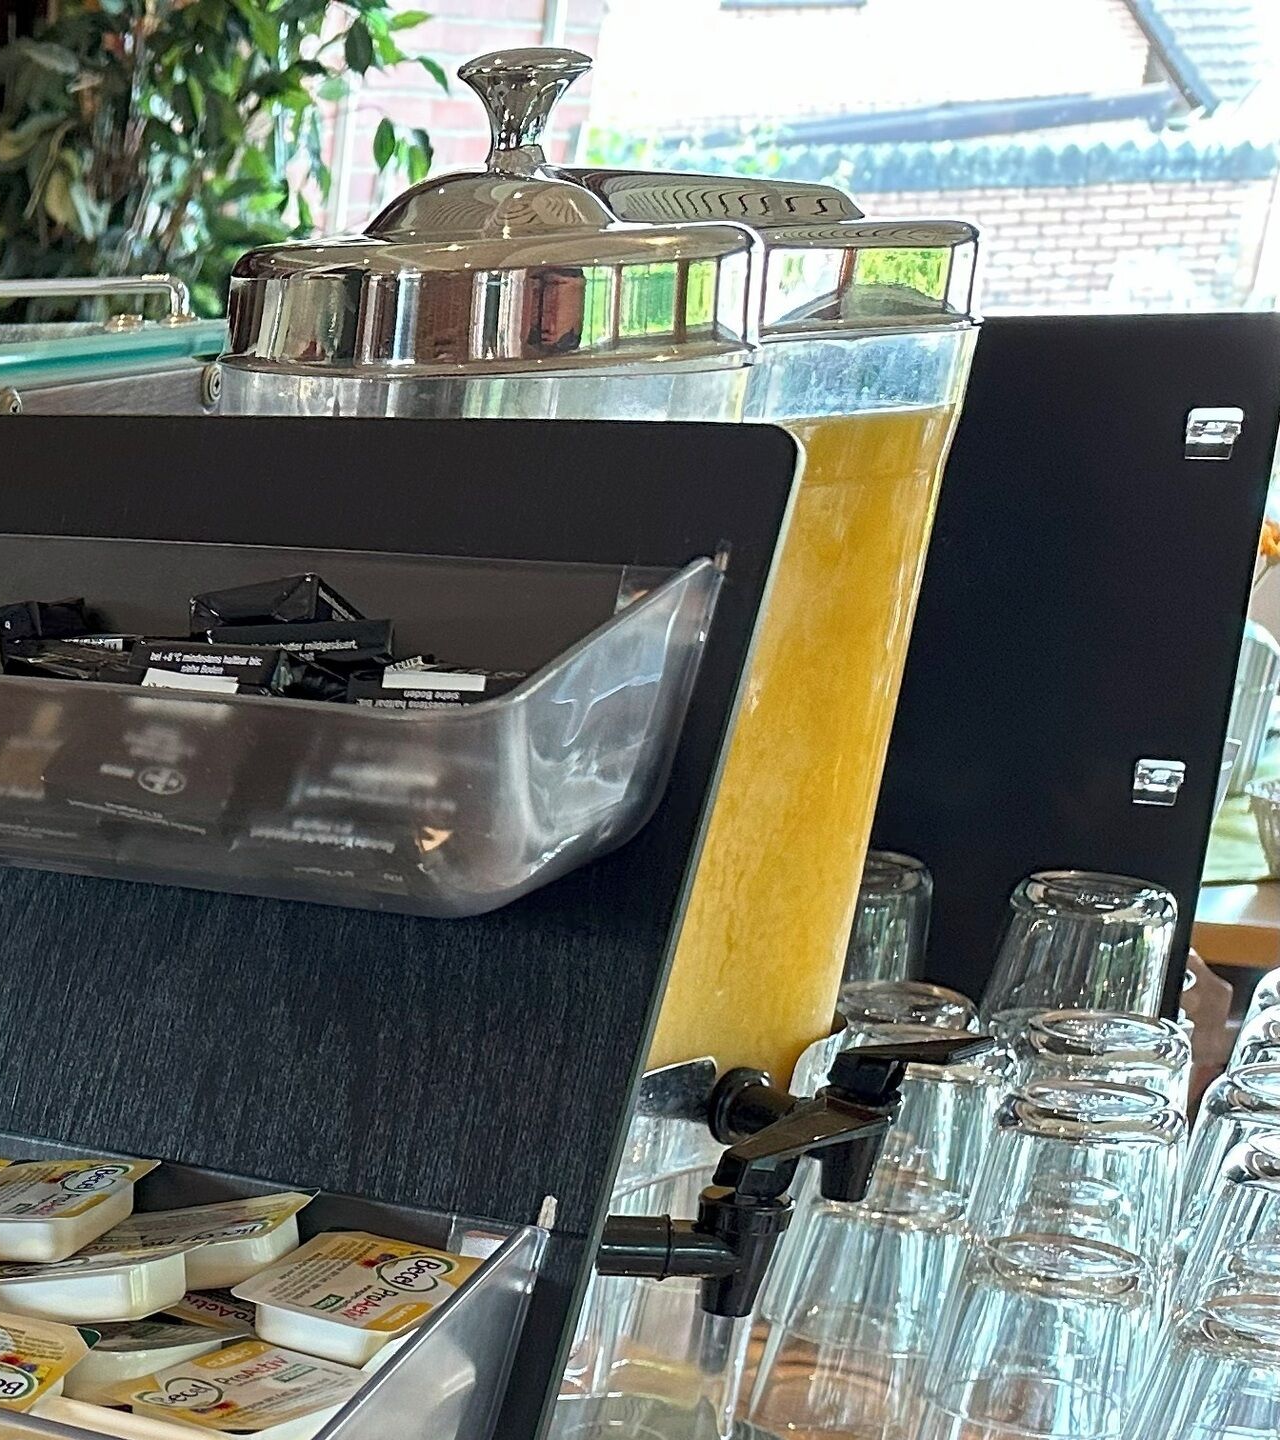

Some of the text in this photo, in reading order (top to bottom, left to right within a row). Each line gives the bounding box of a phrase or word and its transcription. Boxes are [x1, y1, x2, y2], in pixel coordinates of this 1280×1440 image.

[150, 652, 162, 662] bei
[182, 652, 222, 665] mindestens
[223, 655, 248, 666] haltbar
[180, 664, 224, 675] siehe Boden
[403, 690, 460, 700] siehe Boden
[393, 1259, 442, 1288] Becel
[342, 1286, 400, 1322] ProActiv
[215, 1355, 288, 1386] ProActiv
